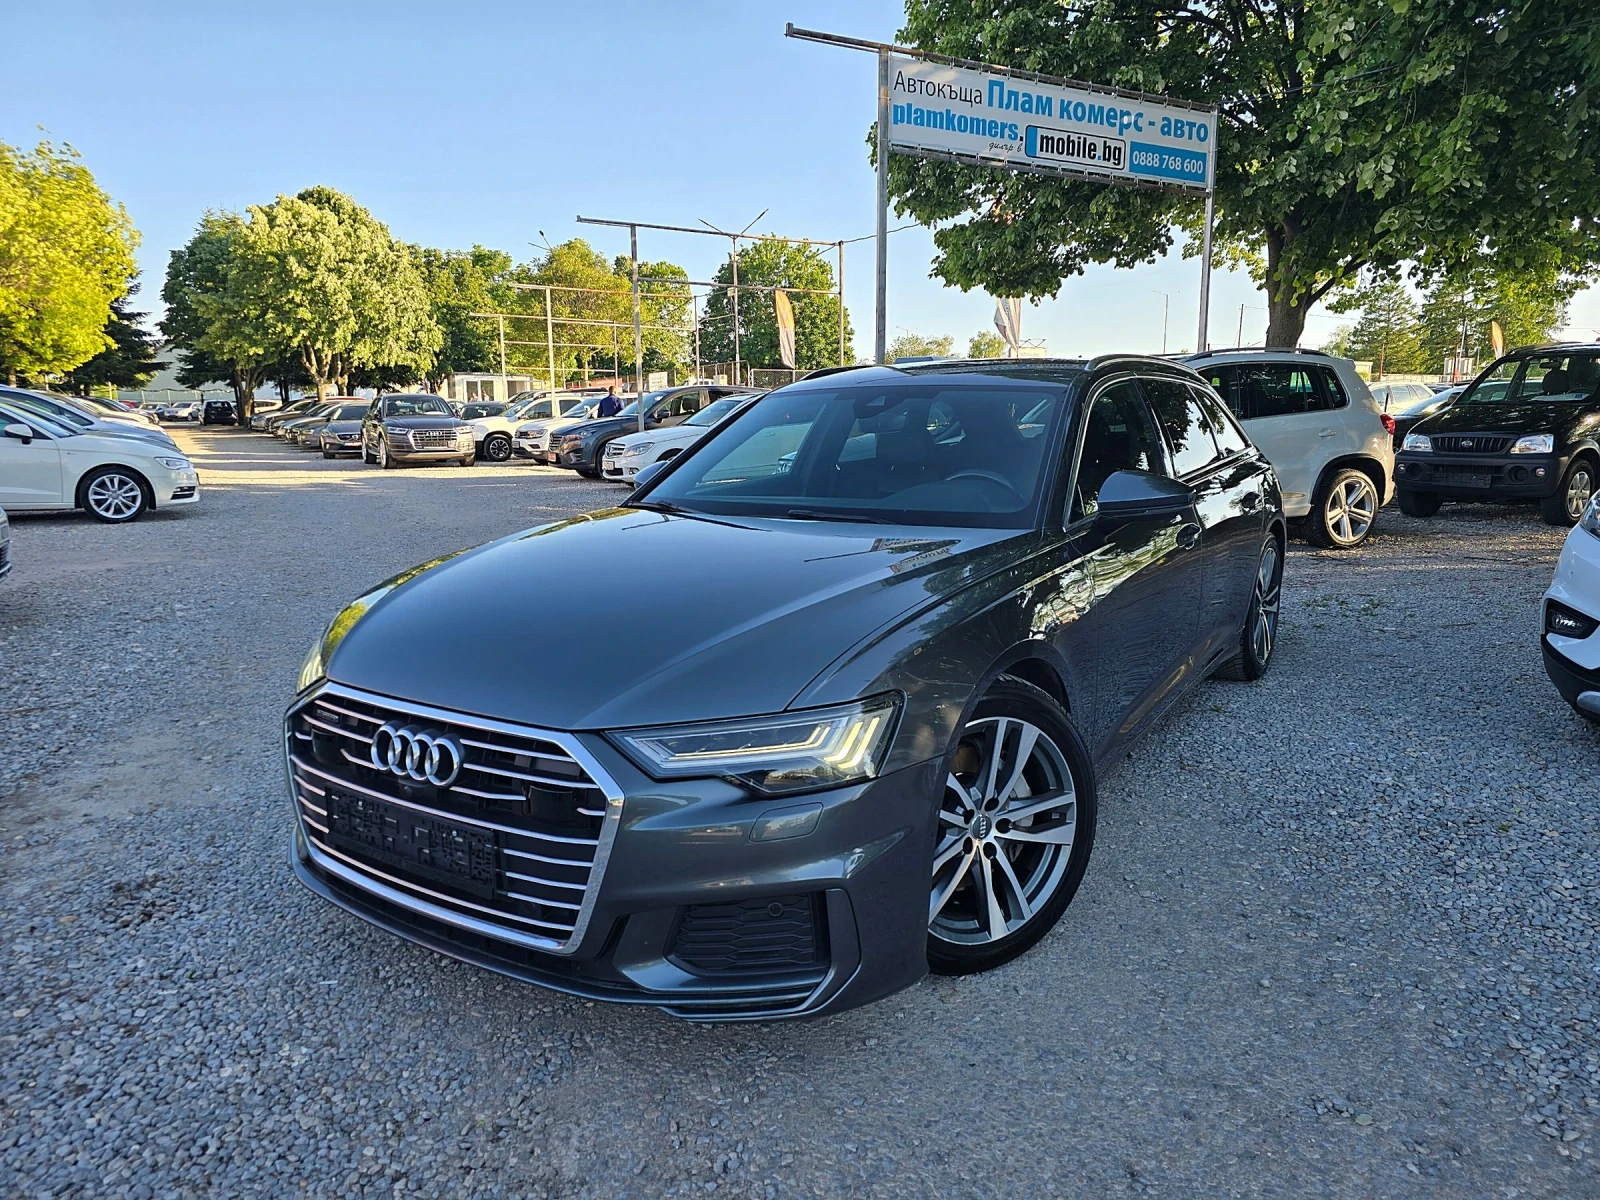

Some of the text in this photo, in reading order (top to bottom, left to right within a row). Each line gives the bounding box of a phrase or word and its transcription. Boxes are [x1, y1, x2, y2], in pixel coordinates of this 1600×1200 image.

[893, 70, 983, 107] Автокъща
[987, 79, 1053, 117] Плам
[1059, 98, 1144, 136] комерс
[1160, 116, 1209, 142] авто
[1038, 133, 1122, 166] mobile.bg
[1132, 151, 1203, 174] 0888 768 600
